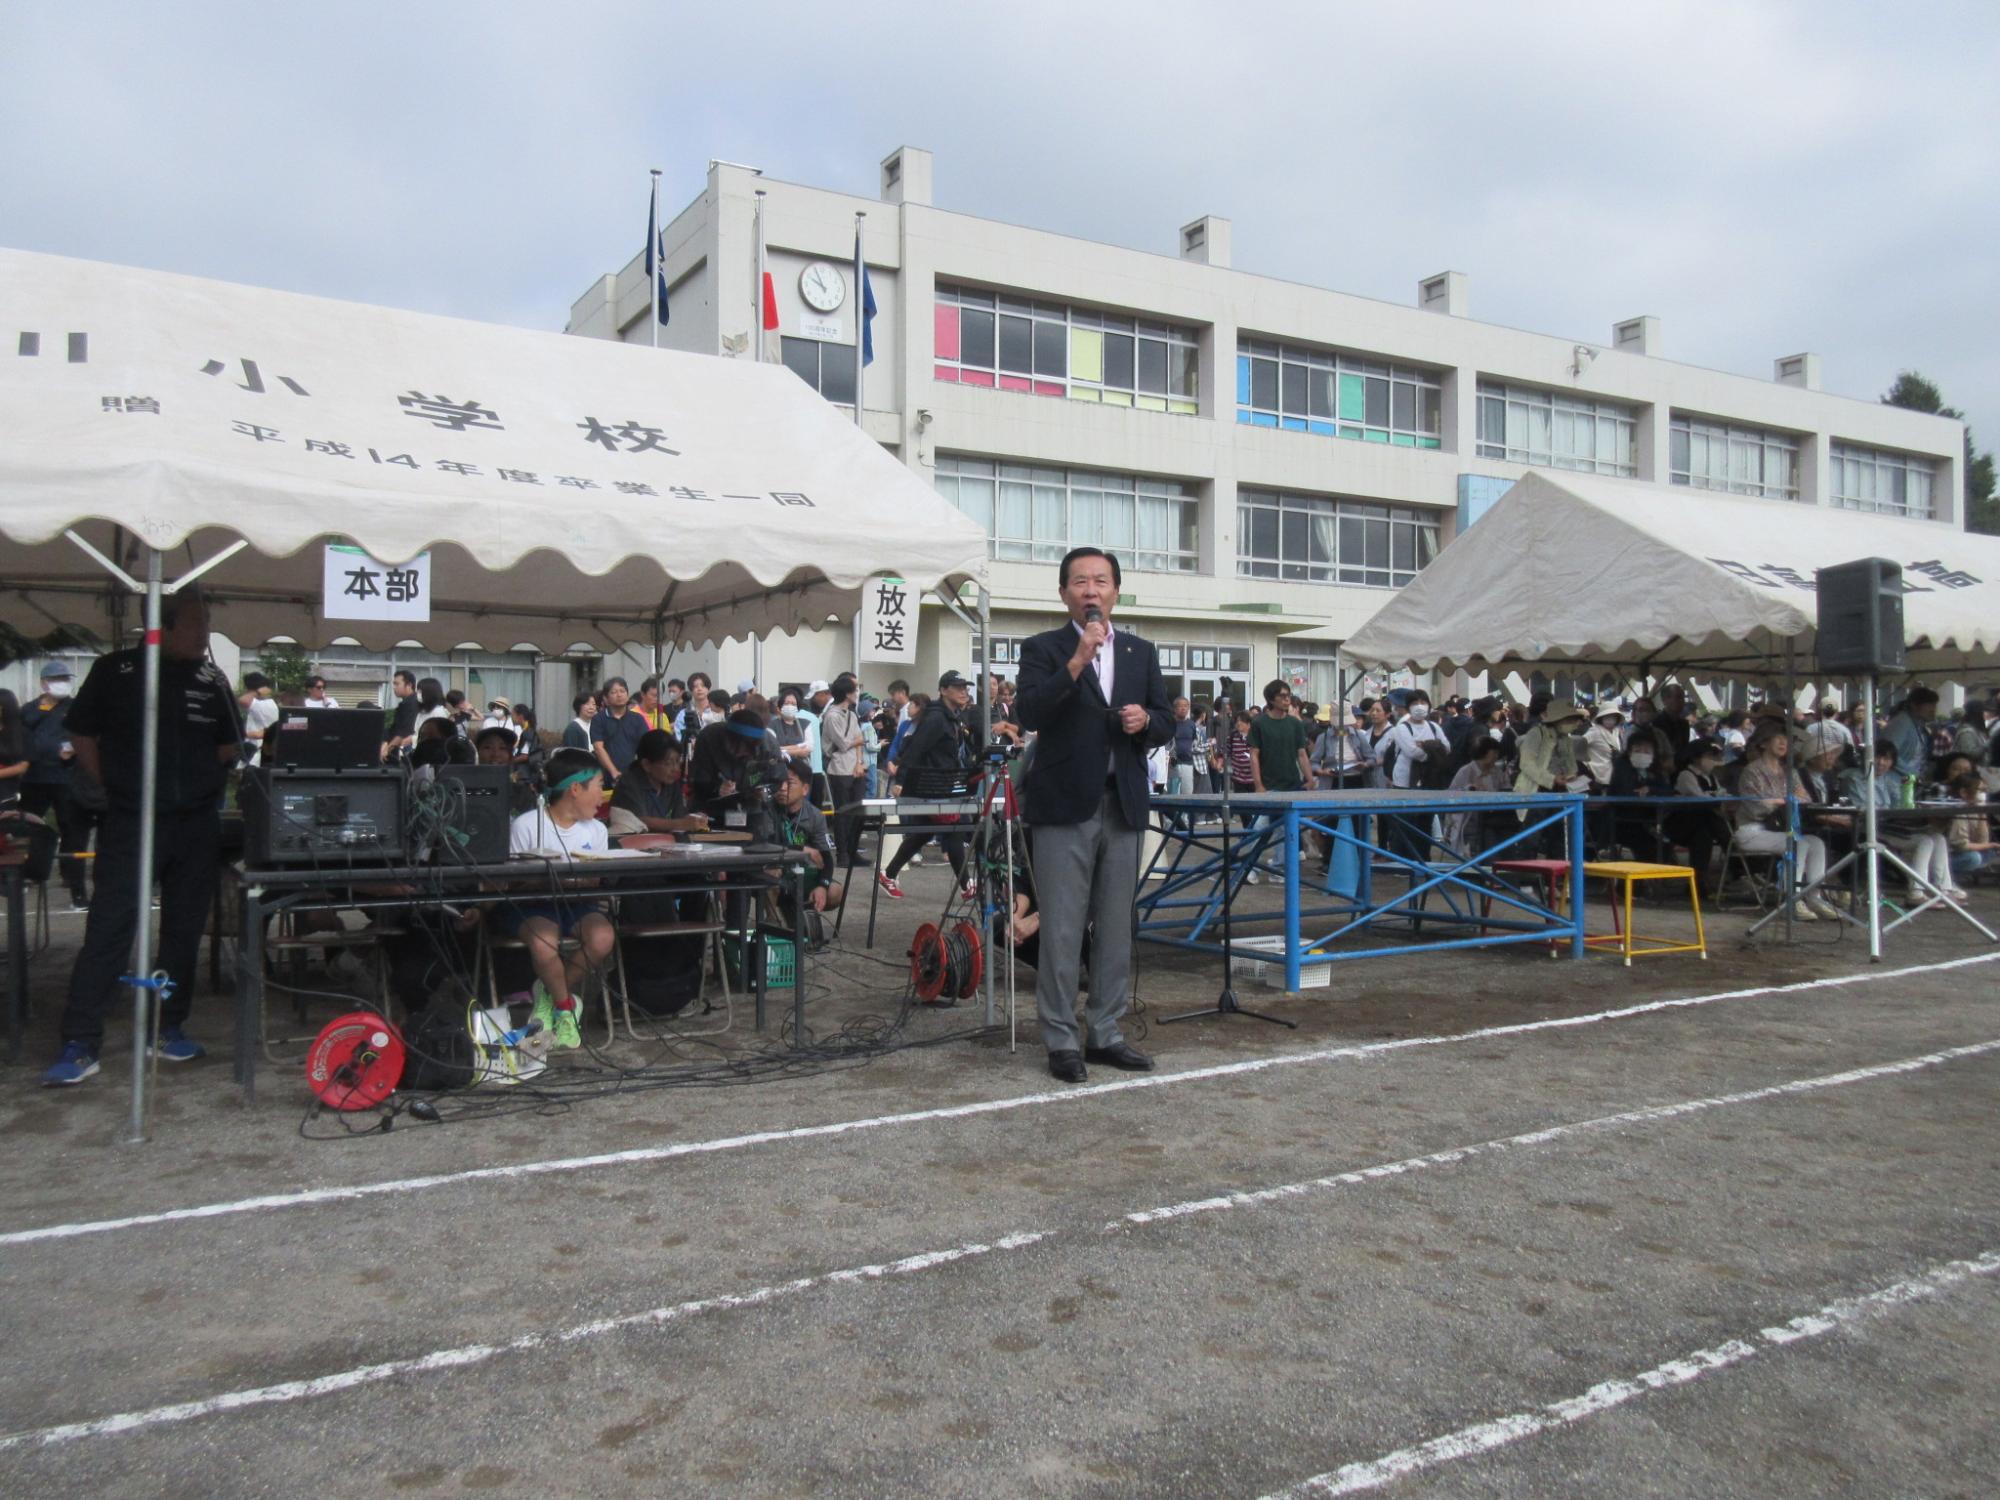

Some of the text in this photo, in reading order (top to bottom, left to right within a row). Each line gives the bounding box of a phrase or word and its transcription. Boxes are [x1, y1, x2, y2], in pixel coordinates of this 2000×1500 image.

[101, 395, 816, 508] 贈 平成14年度卒業生一同
[343, 566, 420, 603] 本部
[874, 582, 908, 652] 放送
